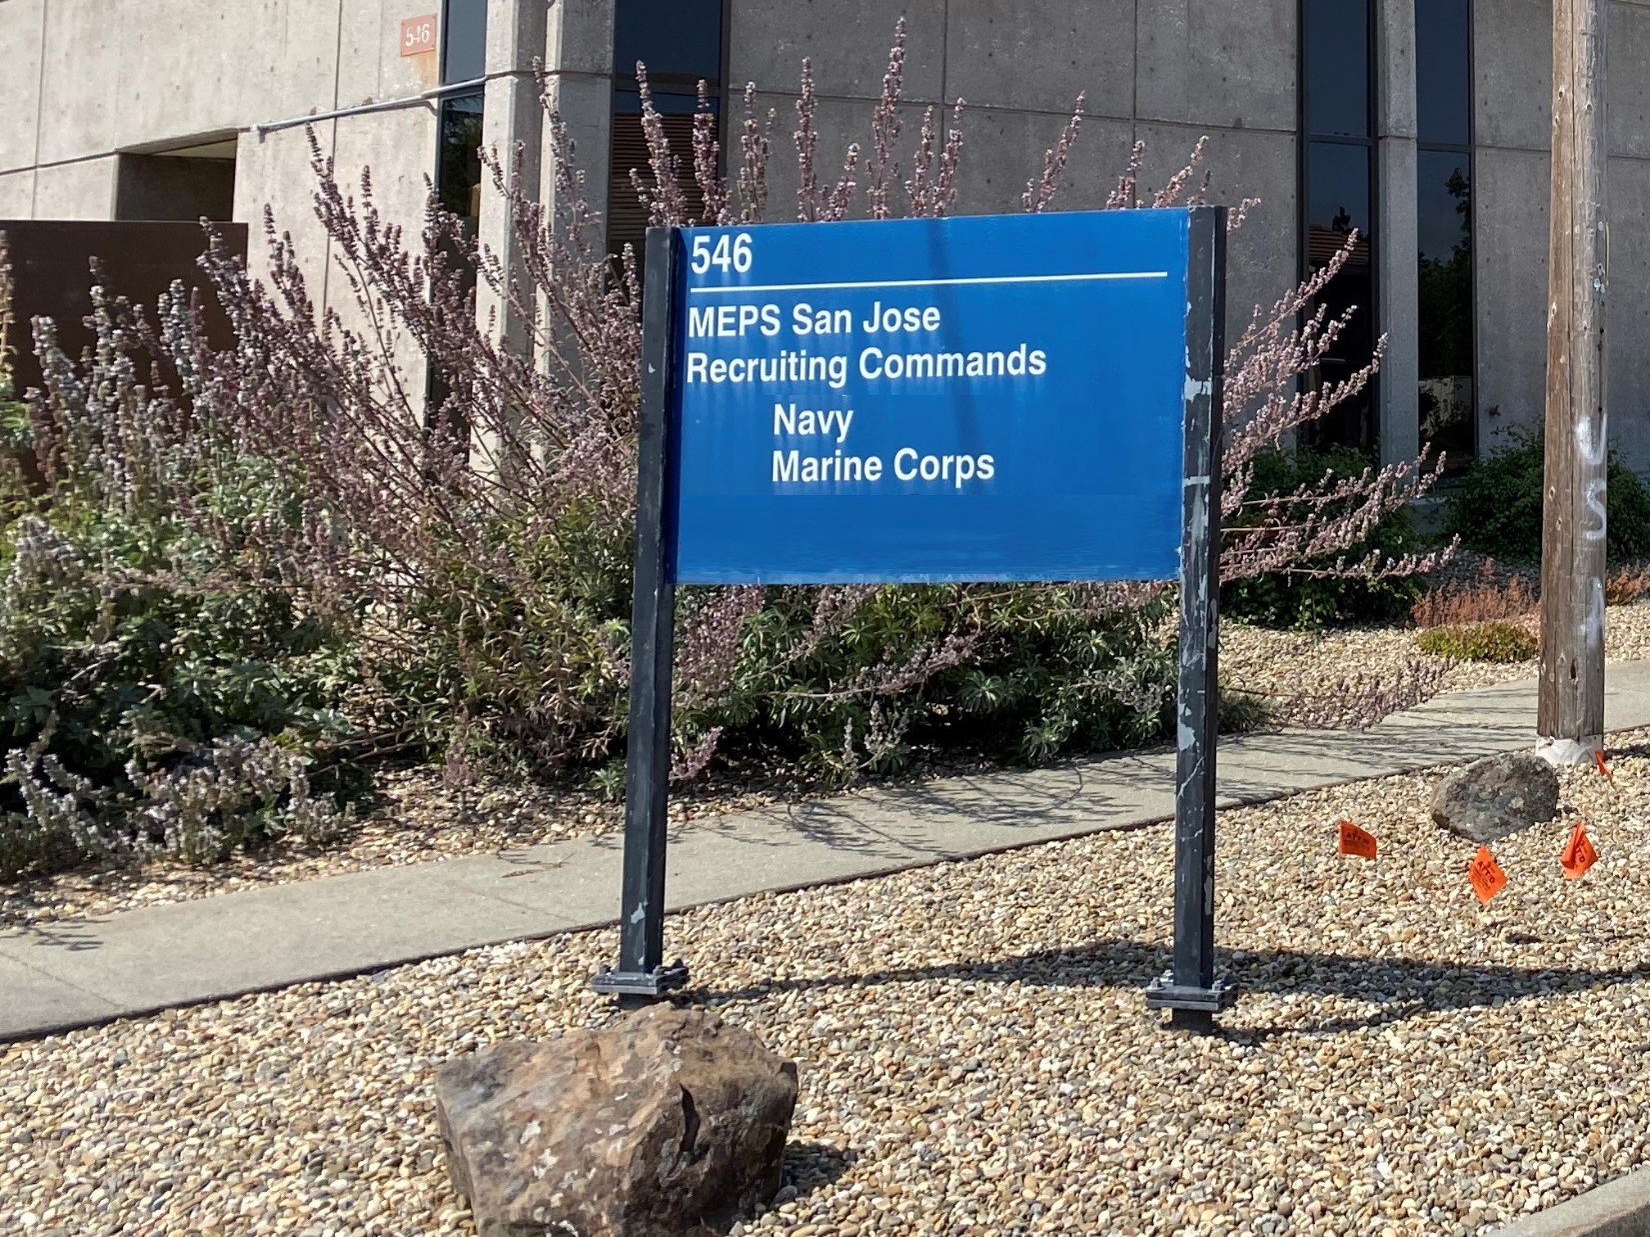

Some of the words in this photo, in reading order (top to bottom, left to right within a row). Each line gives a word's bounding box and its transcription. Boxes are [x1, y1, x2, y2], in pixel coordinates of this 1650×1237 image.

[405, 23, 430, 47] 546
[691, 232, 753, 274] 546
[688, 303, 781, 338] MEPS
[792, 302, 852, 336] San
[862, 301, 941, 334] Jose
[686, 350, 848, 389] Recruiting
[859, 343, 1047, 380] Commands
[773, 403, 854, 444] Navy
[772, 448, 883, 483] Marine
[893, 447, 995, 489] Corps
